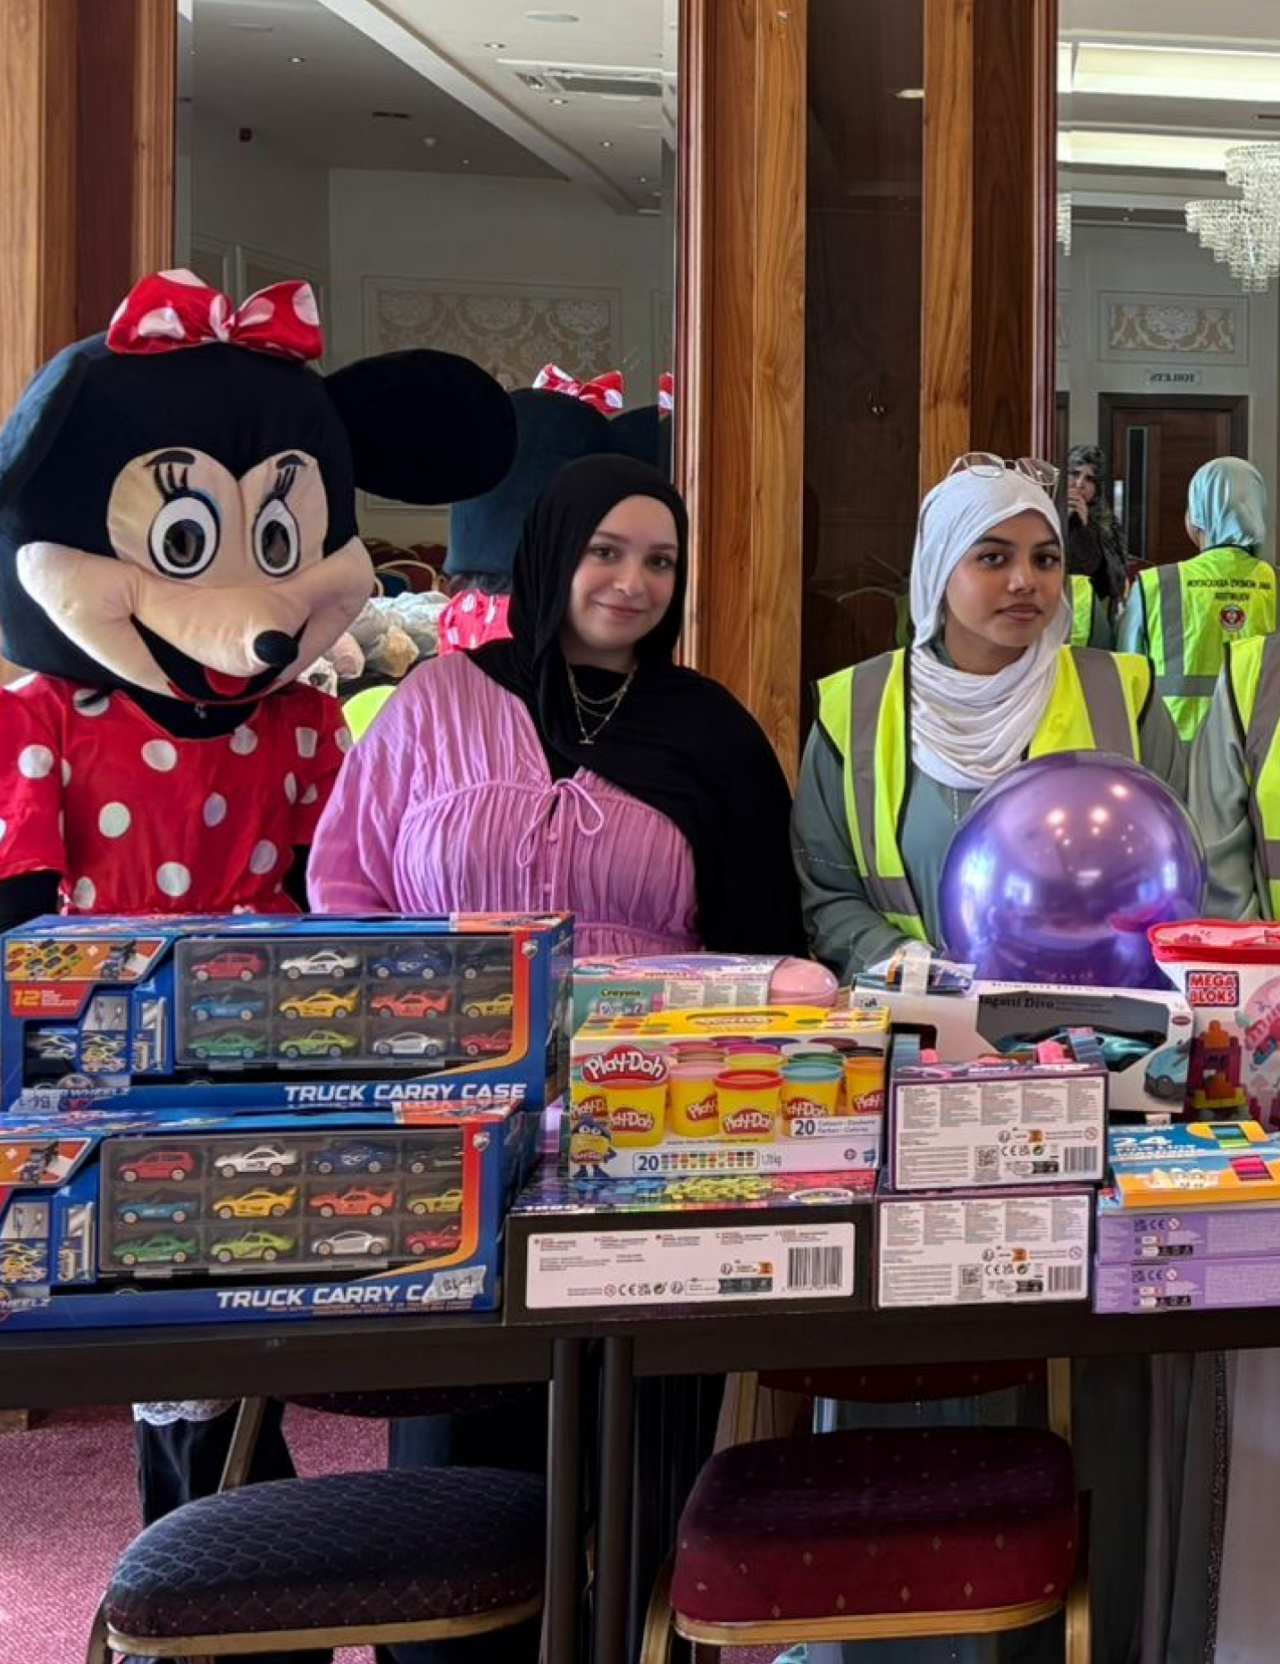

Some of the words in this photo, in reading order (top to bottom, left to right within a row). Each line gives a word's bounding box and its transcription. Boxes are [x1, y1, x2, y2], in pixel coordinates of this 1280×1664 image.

[1190, 973, 1234, 987] MEGA
[14, 989, 40, 1007] 12
[1190, 989, 1235, 1003] BLOKS
[284, 1084, 366, 1102] TRUCK
[373, 1083, 456, 1101] CARRY
[460, 1083, 528, 1100] CASE
[794, 1119, 816, 1135] 20
[637, 1155, 659, 1171] 20
[216, 1288, 305, 1309] TRUCK
[312, 1285, 400, 1305] CARRY
[405, 1281, 476, 1304] CASE
